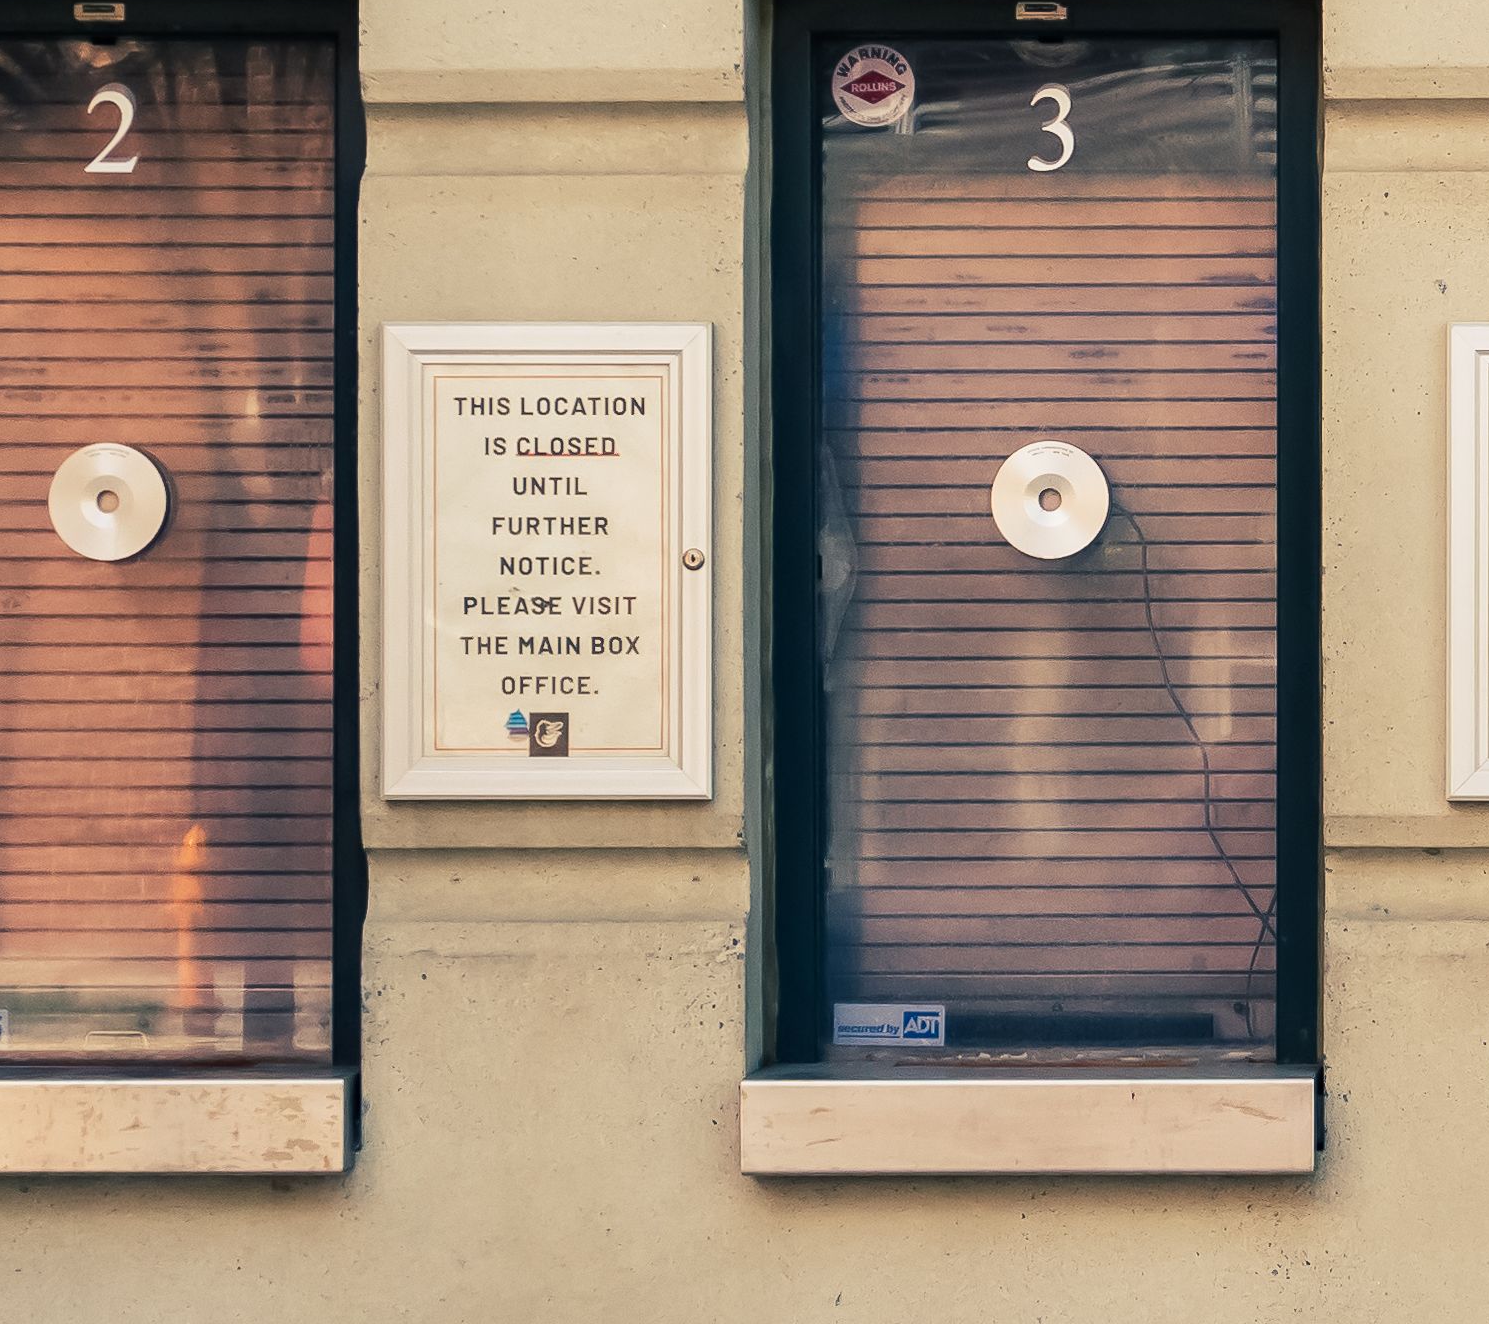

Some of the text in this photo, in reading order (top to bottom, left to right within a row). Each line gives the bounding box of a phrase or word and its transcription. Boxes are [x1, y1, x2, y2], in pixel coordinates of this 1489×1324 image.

[837, 47, 907, 75] WARNING
[851, 82, 897, 92] ROLLINS
[84, 87, 141, 174] 2
[1027, 84, 1076, 172] 3
[453, 396, 646, 416] THIS LOCATION
[484, 436, 619, 457] IS CLOSED
[512, 476, 588, 496] UNTIL
[492, 516, 609, 536] FURTHER
[499, 556, 601, 576] NOTICE.
[463, 596, 637, 616] PLEASE VISIT
[459, 635, 640, 656] THE MAIN BOX
[501, 675, 599, 695] OFFICE.
[838, 1016, 941, 1034] secured by ADT
